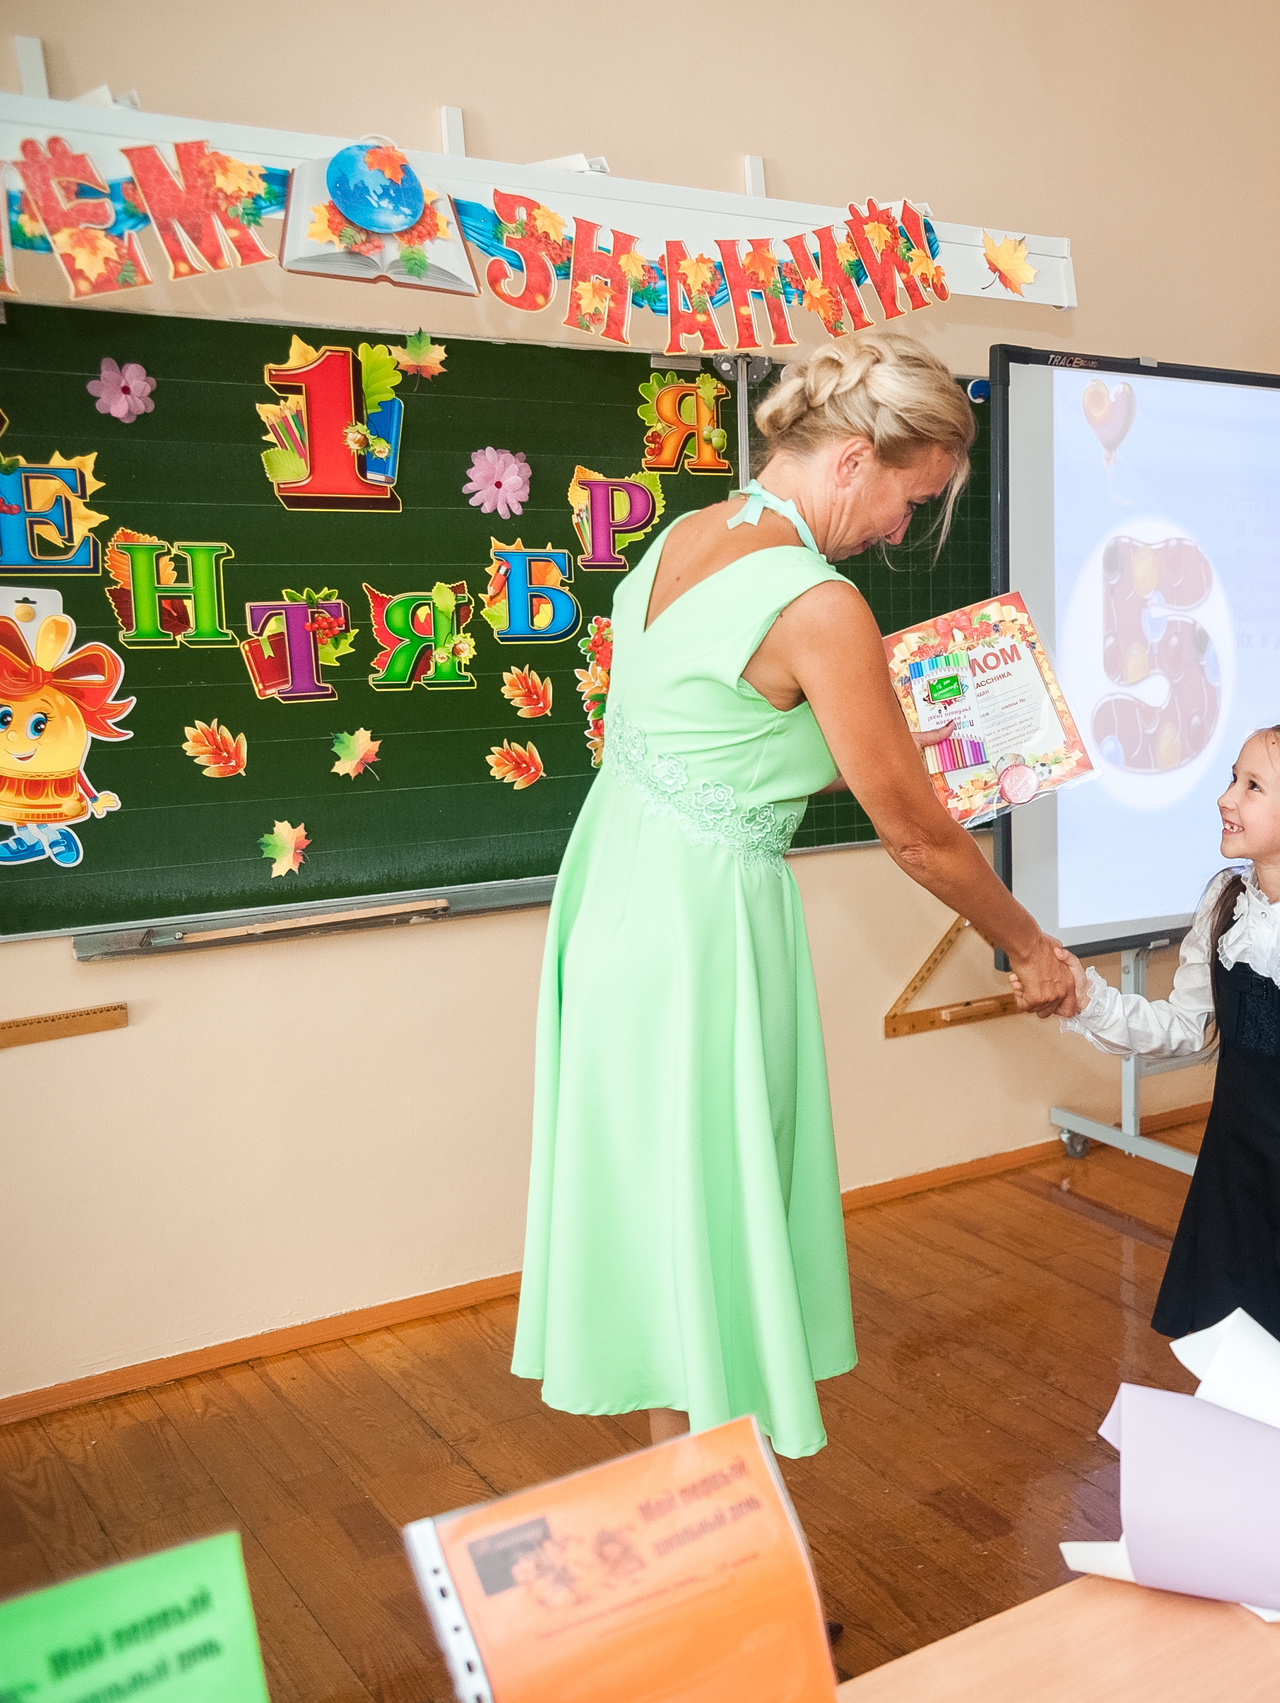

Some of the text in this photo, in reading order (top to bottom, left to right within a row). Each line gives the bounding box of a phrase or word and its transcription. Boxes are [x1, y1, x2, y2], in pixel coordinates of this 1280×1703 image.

[0, 134, 950, 356] ЁМ ЗНАНИЙ!
[264, 345, 402, 511] 1
[0, 382, 734, 703] ЕНТЯБРЯ
[970, 643, 1022, 678] ЛОМ
